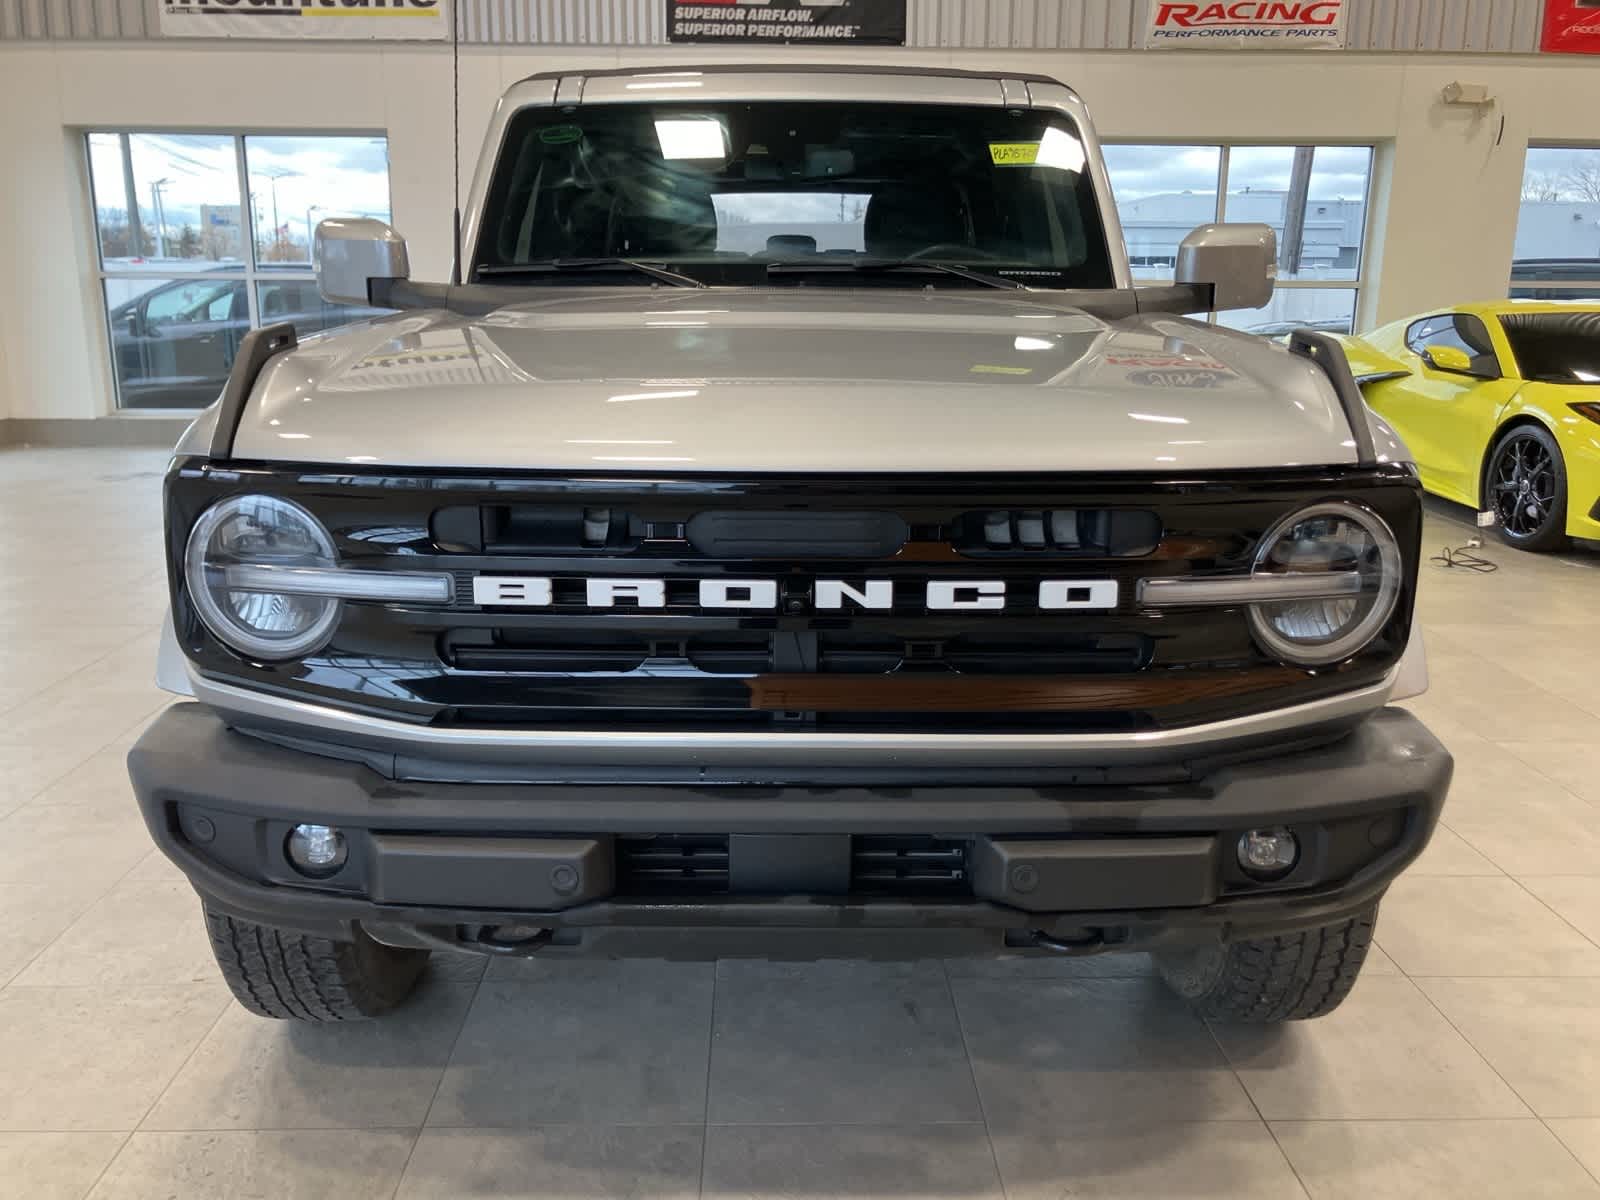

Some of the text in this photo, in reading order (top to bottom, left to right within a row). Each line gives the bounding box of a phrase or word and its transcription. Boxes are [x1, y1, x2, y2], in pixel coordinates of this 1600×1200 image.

[674, 7, 814, 22] SUPERIOR AIRFLOW.
[1155, 2, 1341, 27] RACING
[674, 23, 746, 37] SUPERIOR
[1153, 29, 1337, 38] PERFORMANCE PARTS
[472, 576, 1119, 612] BRONCO
